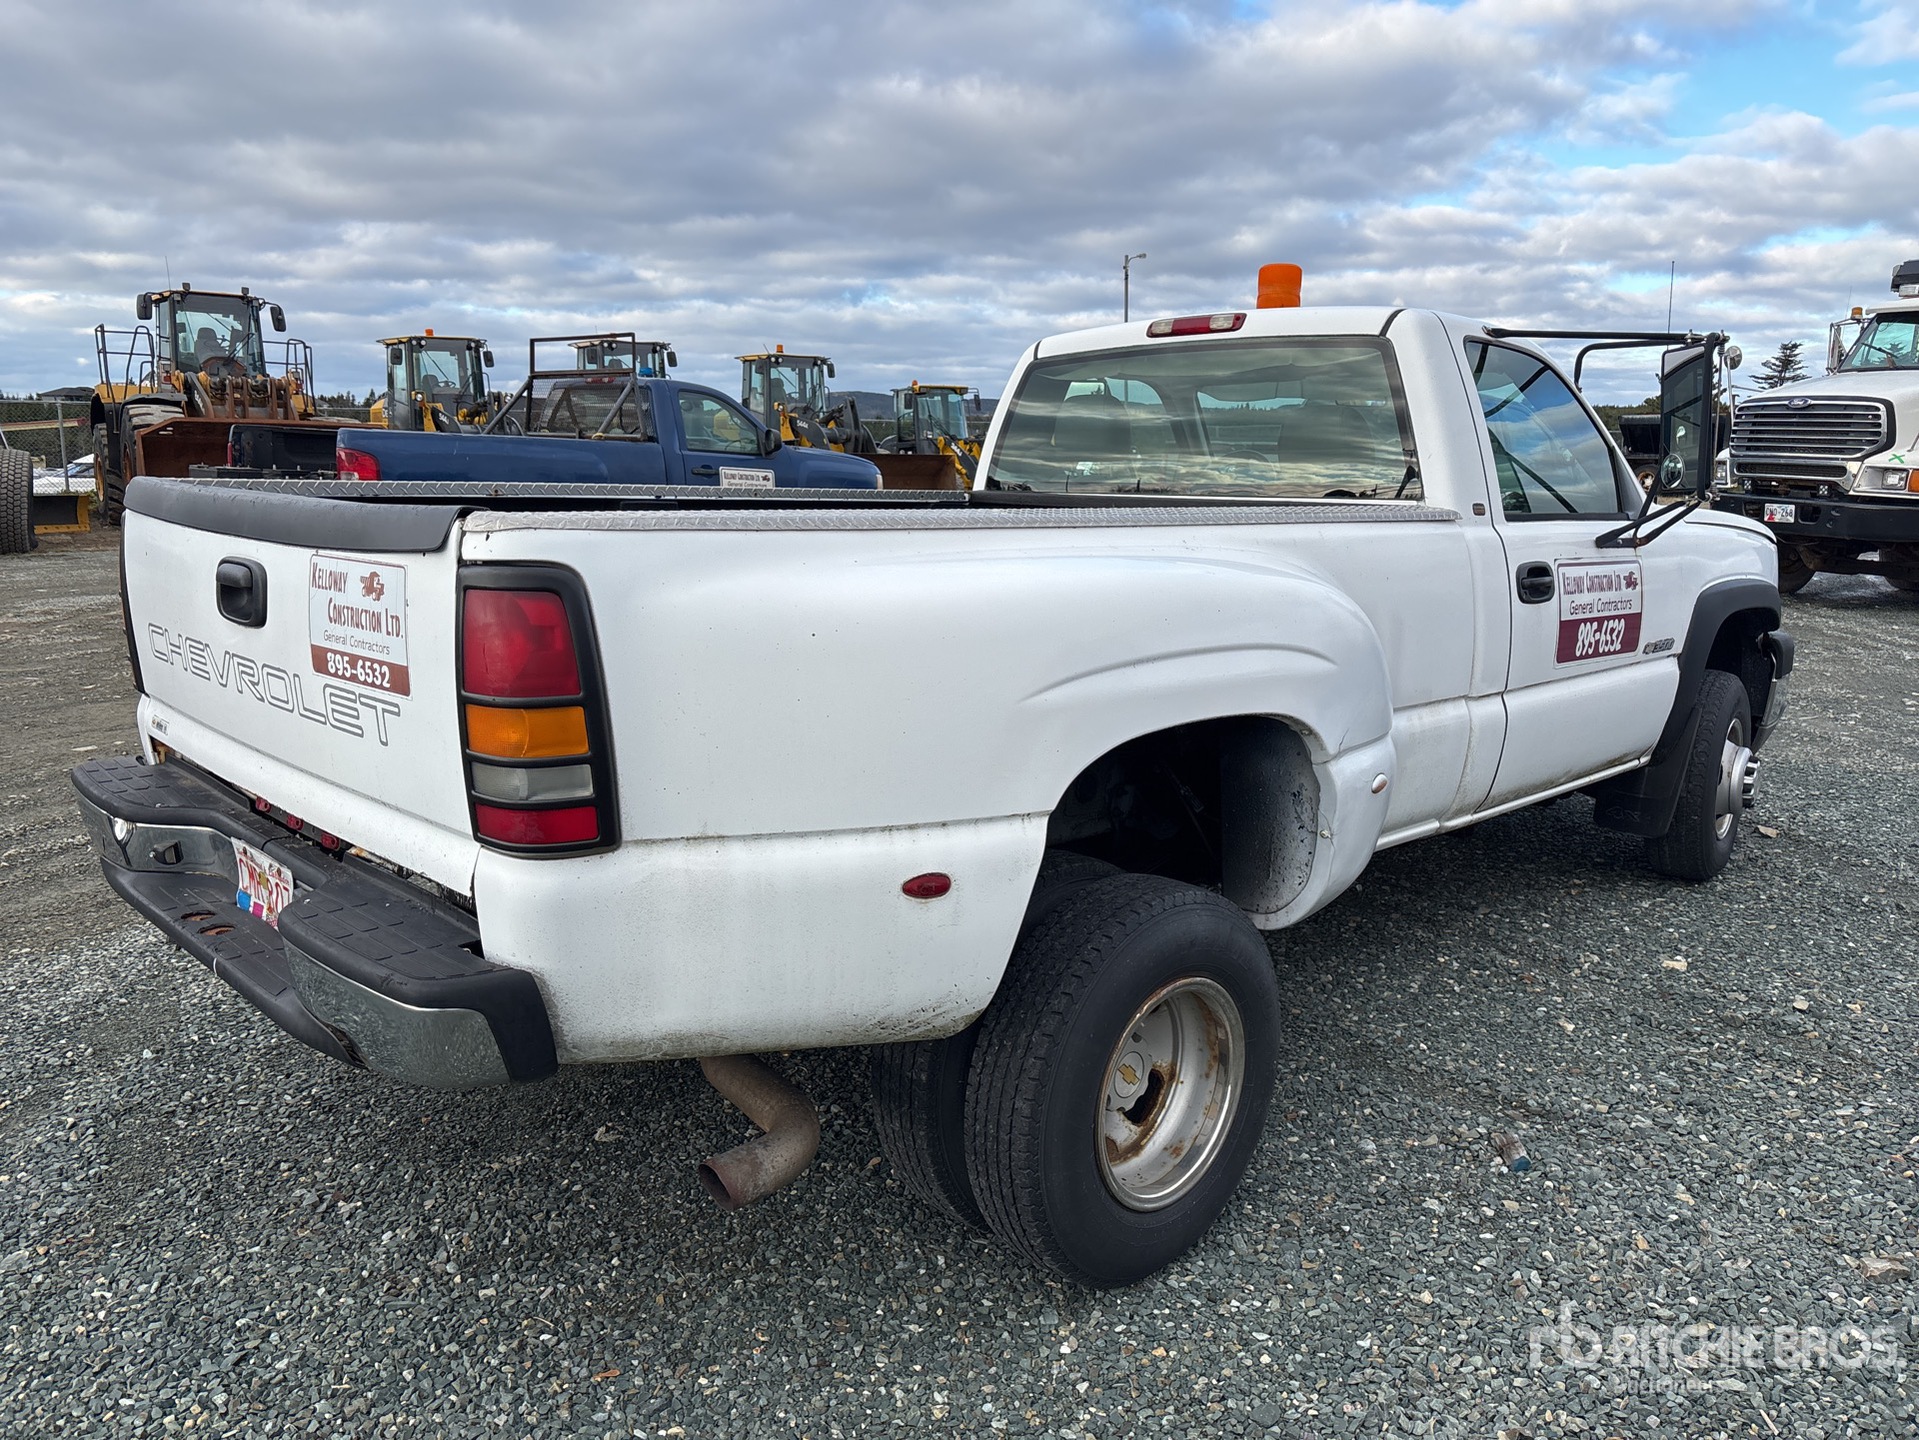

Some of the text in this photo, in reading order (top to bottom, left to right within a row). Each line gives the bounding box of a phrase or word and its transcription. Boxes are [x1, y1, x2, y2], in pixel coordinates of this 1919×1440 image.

[312, 562, 348, 594] KELLOWAY
[328, 597, 382, 634] CONSTRUCTION
[1569, 597, 1633, 616] General Contractors
[324, 629, 390, 656] General Contractors
[1575, 618, 1625, 657] 895-6532
[148, 622, 401, 747] CHEVROLET
[326, 651, 391, 688] 895-6532
